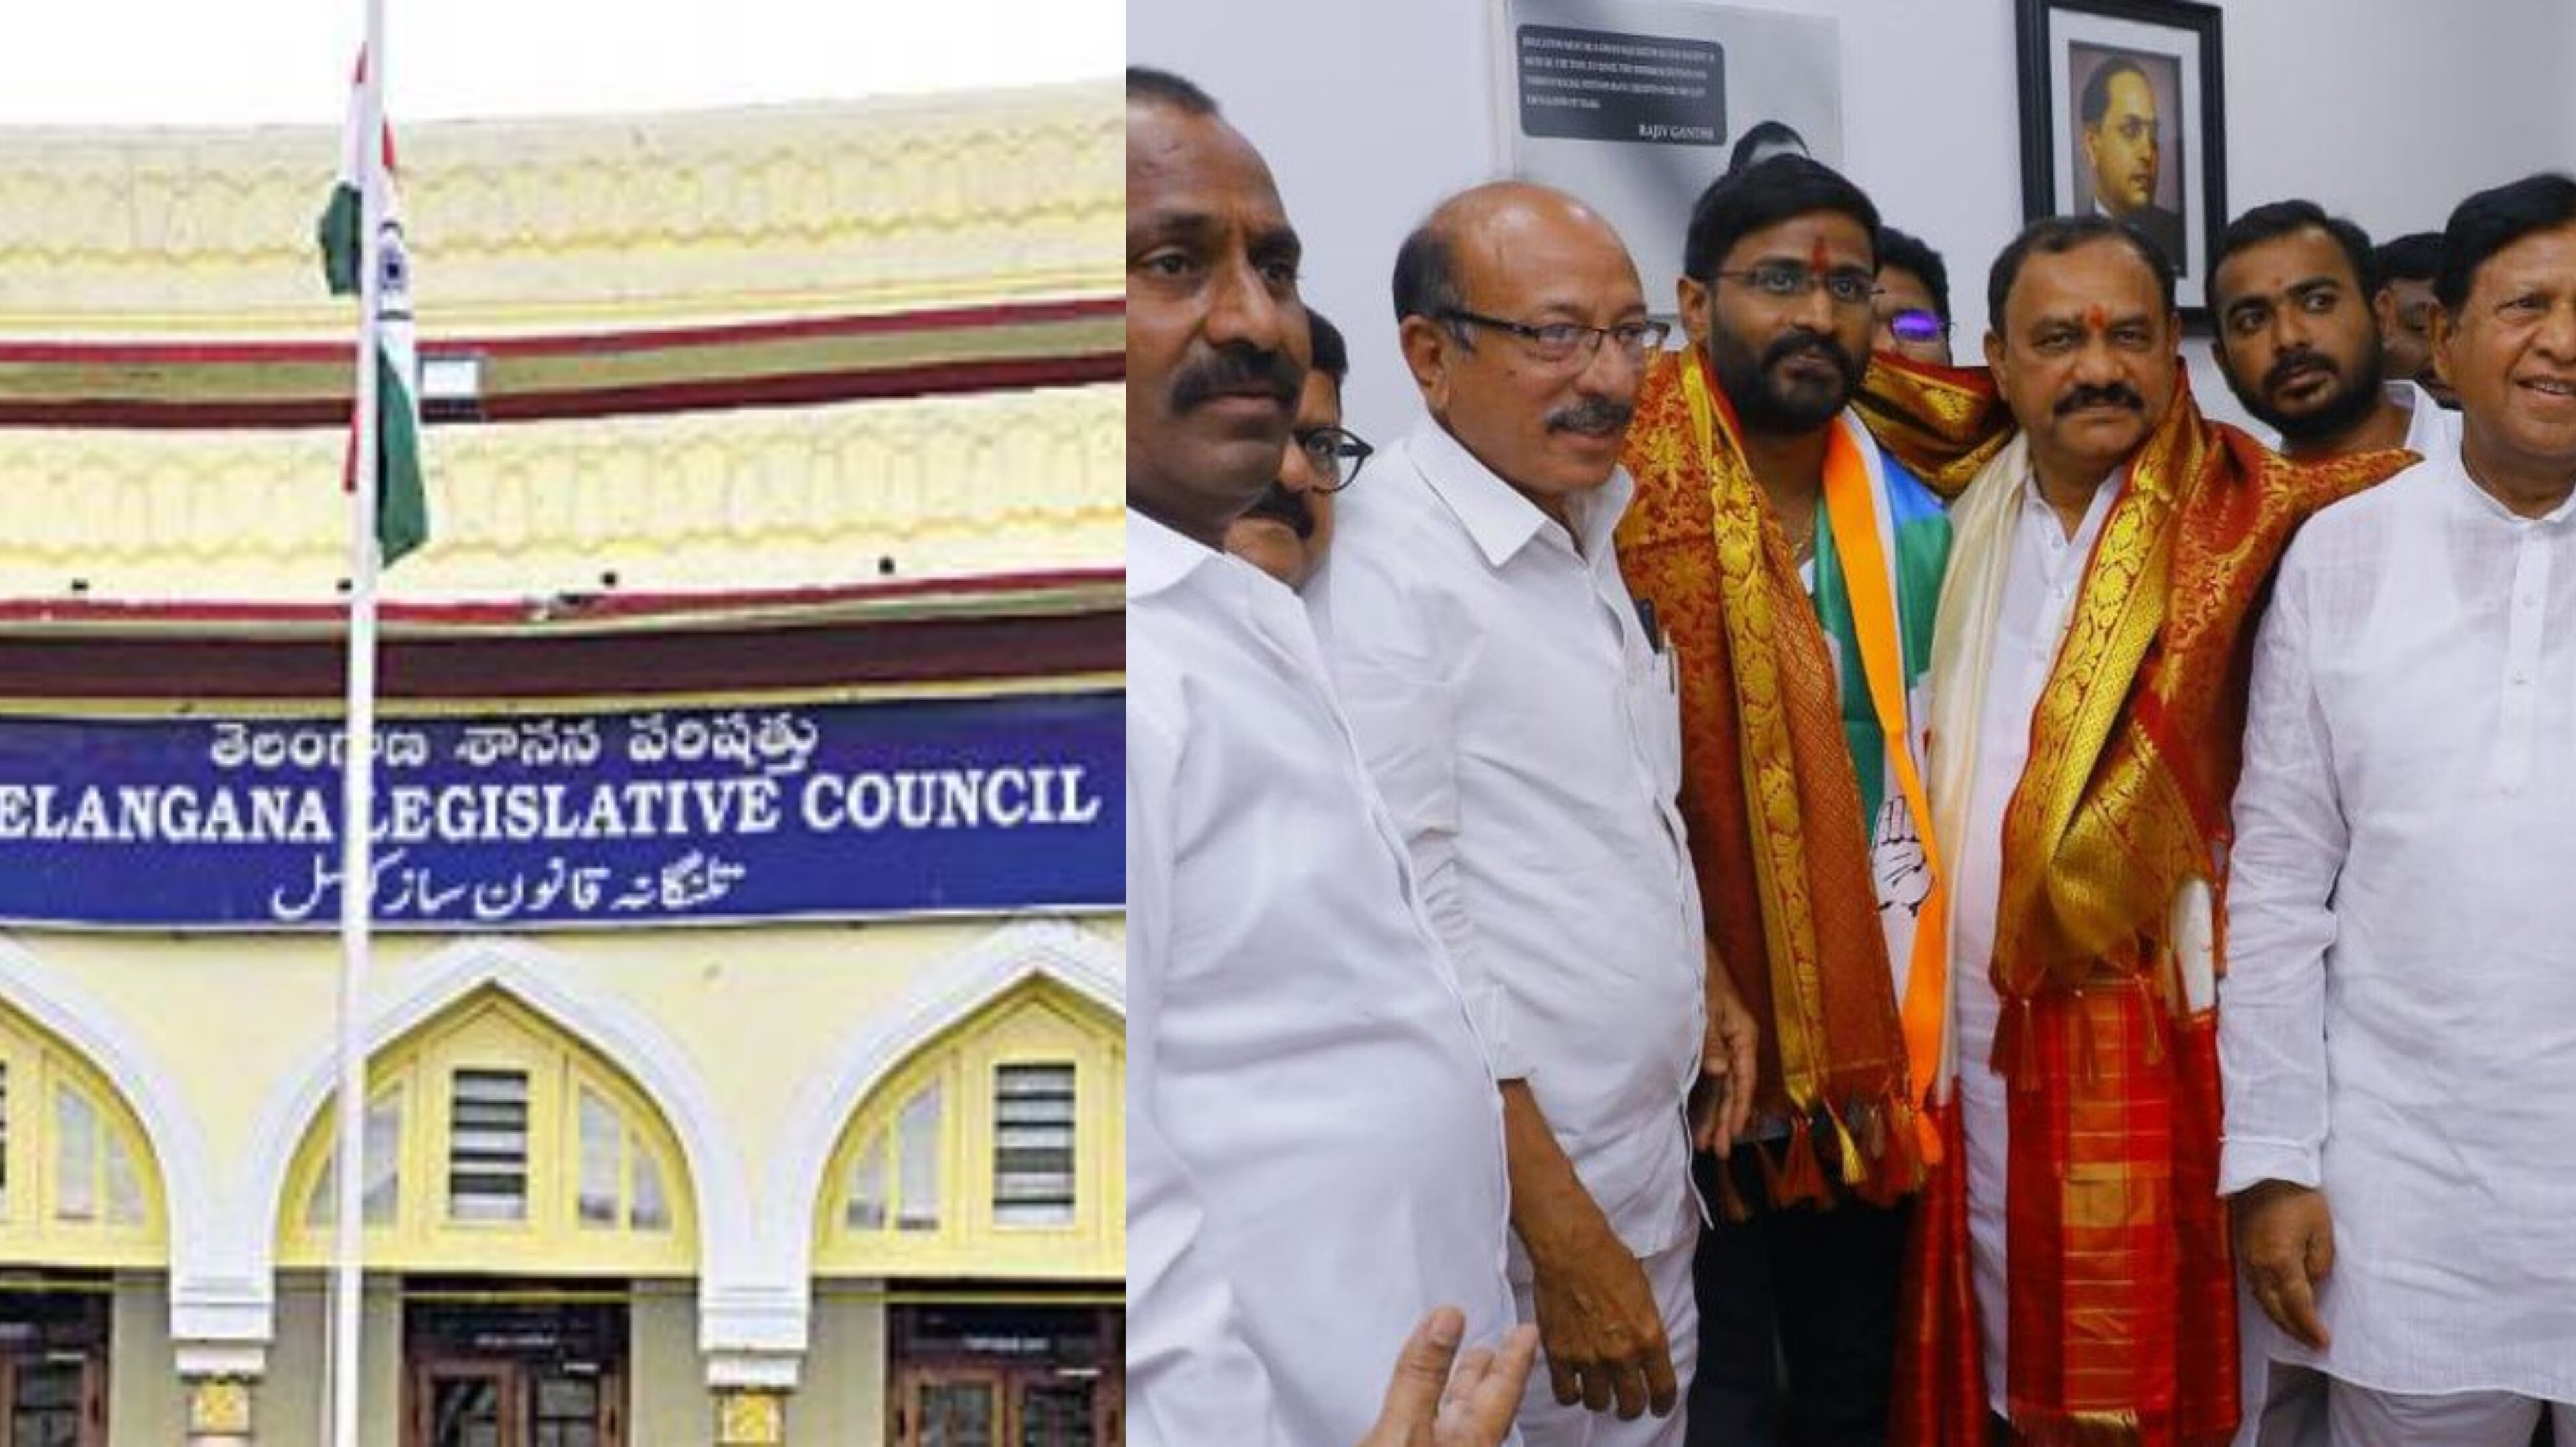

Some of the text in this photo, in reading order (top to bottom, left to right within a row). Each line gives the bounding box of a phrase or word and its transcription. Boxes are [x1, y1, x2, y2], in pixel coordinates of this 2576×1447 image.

[454, 719, 601, 767] శాసన
[628, 712, 819, 777] పరిషత్తు
[0, 783, 333, 843] ELANGANA
[801, 765, 1101, 831] COUNCIL
